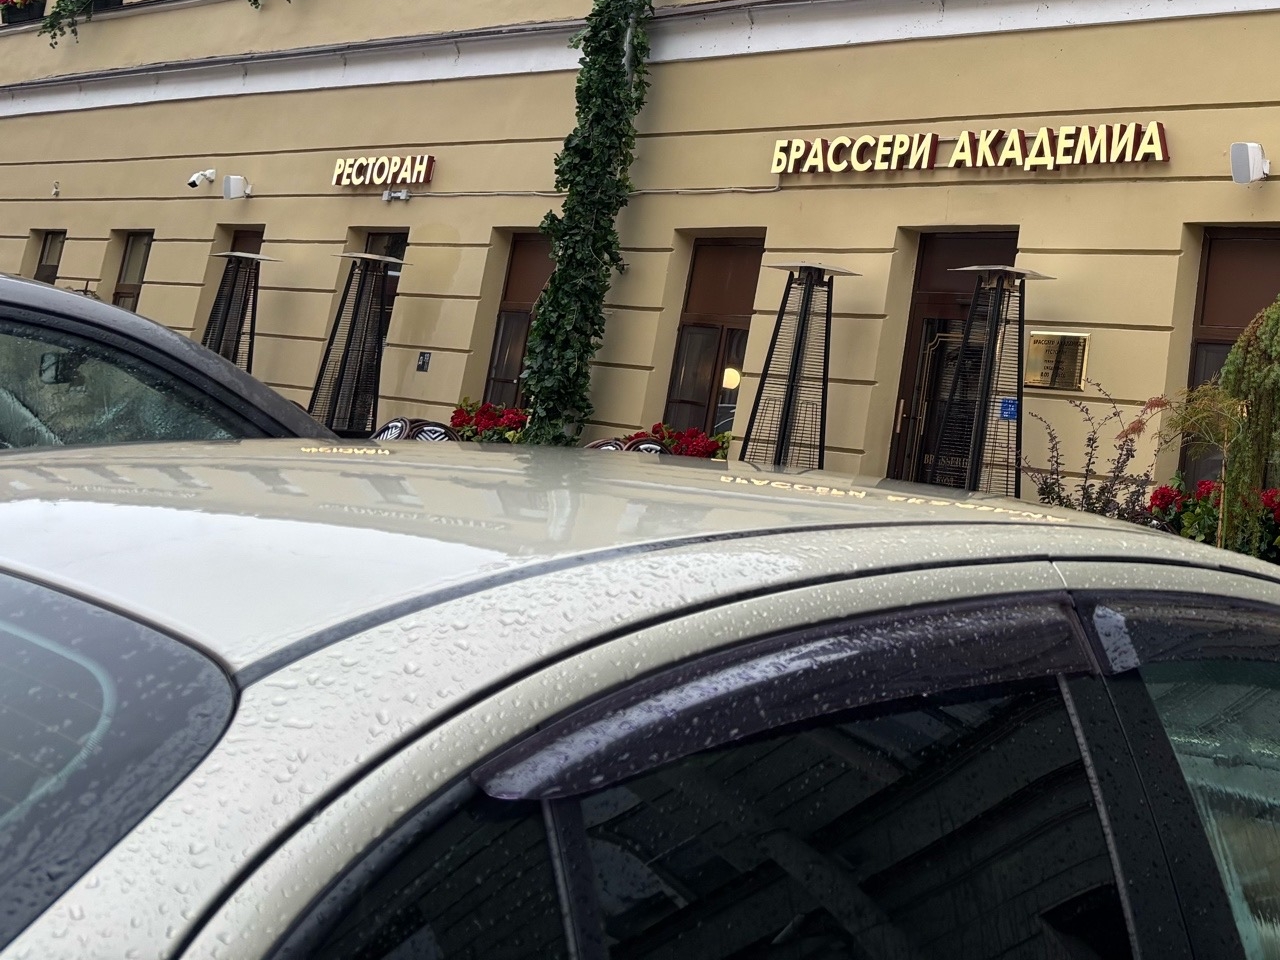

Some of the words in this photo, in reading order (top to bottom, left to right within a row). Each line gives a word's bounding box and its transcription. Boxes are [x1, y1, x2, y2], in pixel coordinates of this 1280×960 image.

[771, 132, 938, 174] БРАССЕРИ
[948, 120, 1170, 171] АКАДЕМИА
[332, 155, 435, 186] РЕСТОРАН
